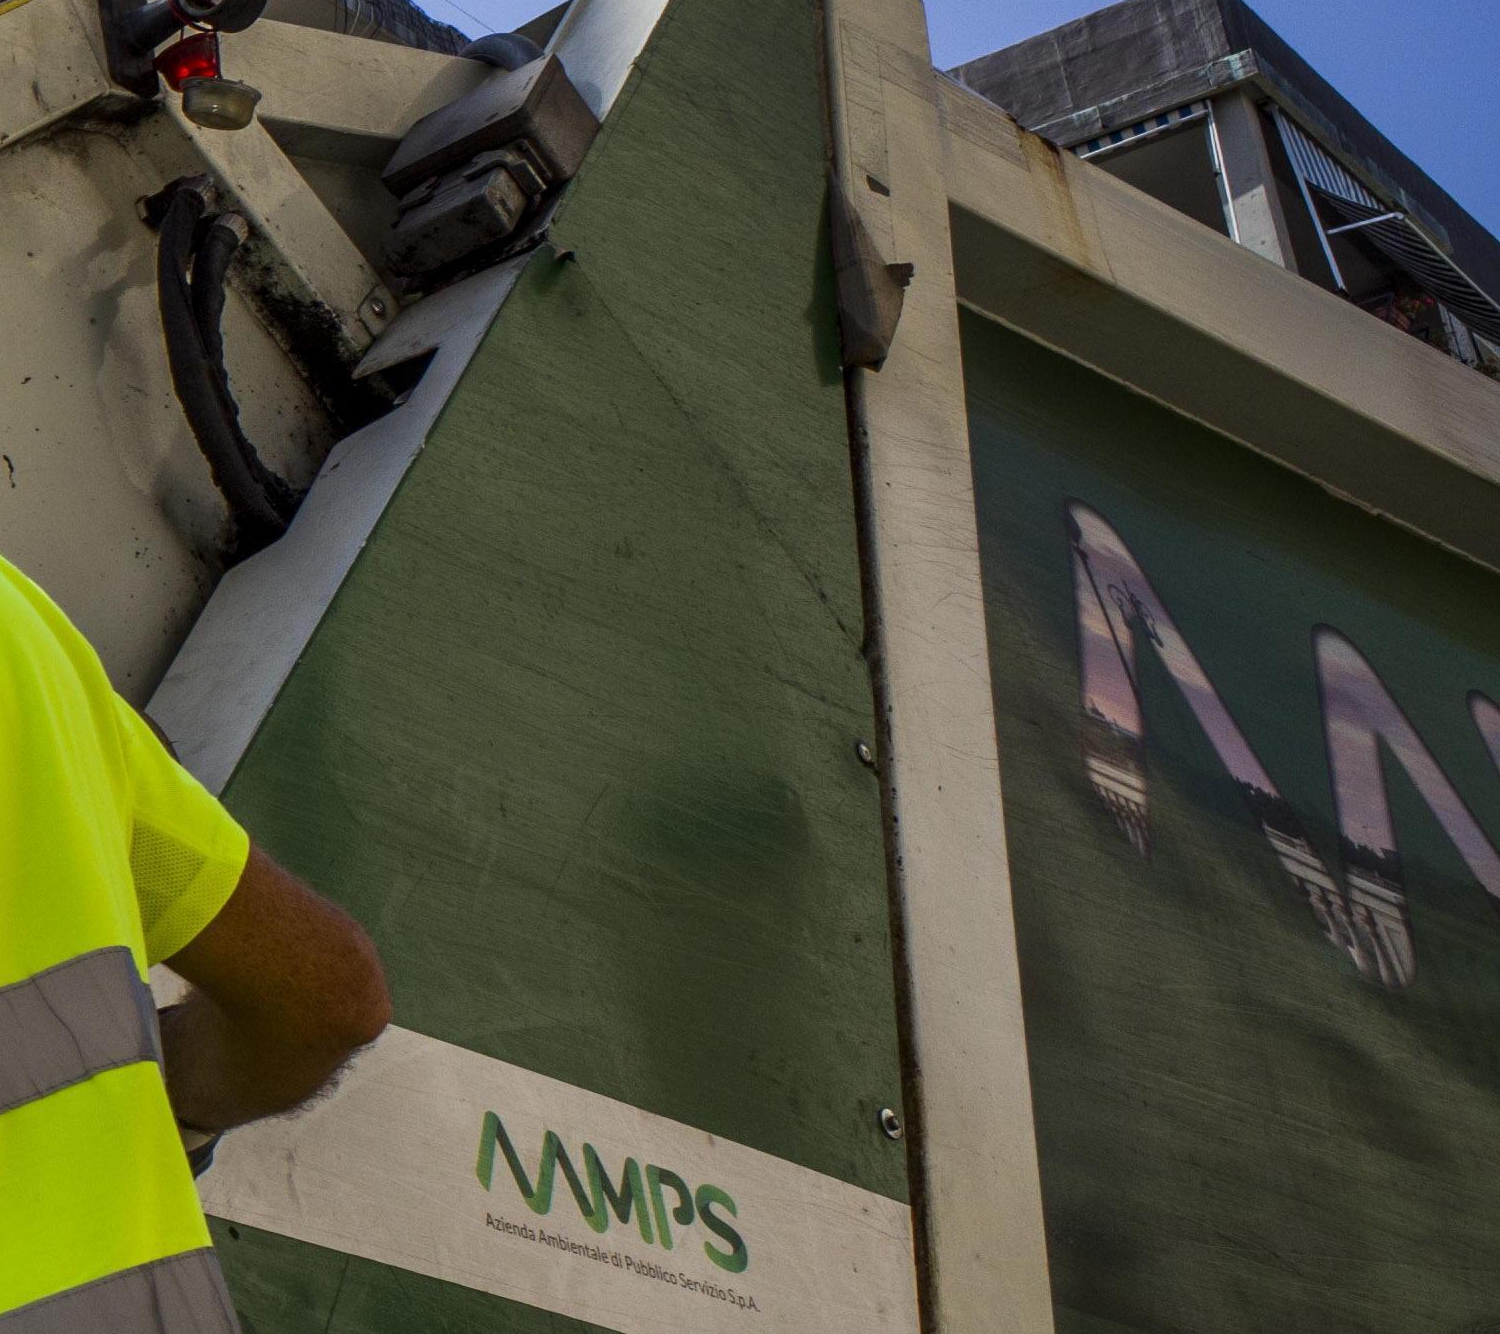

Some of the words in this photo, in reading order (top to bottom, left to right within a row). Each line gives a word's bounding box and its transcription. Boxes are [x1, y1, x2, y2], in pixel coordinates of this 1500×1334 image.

[486, 1212, 536, 1242] Azienda
[539, 1229, 610, 1264] Ambientale
[611, 1251, 623, 1268] di
[624, 1255, 678, 1285] Pubblico
[679, 1272, 726, 1301] Servizio
[728, 1288, 761, 1313] S.p.A.
